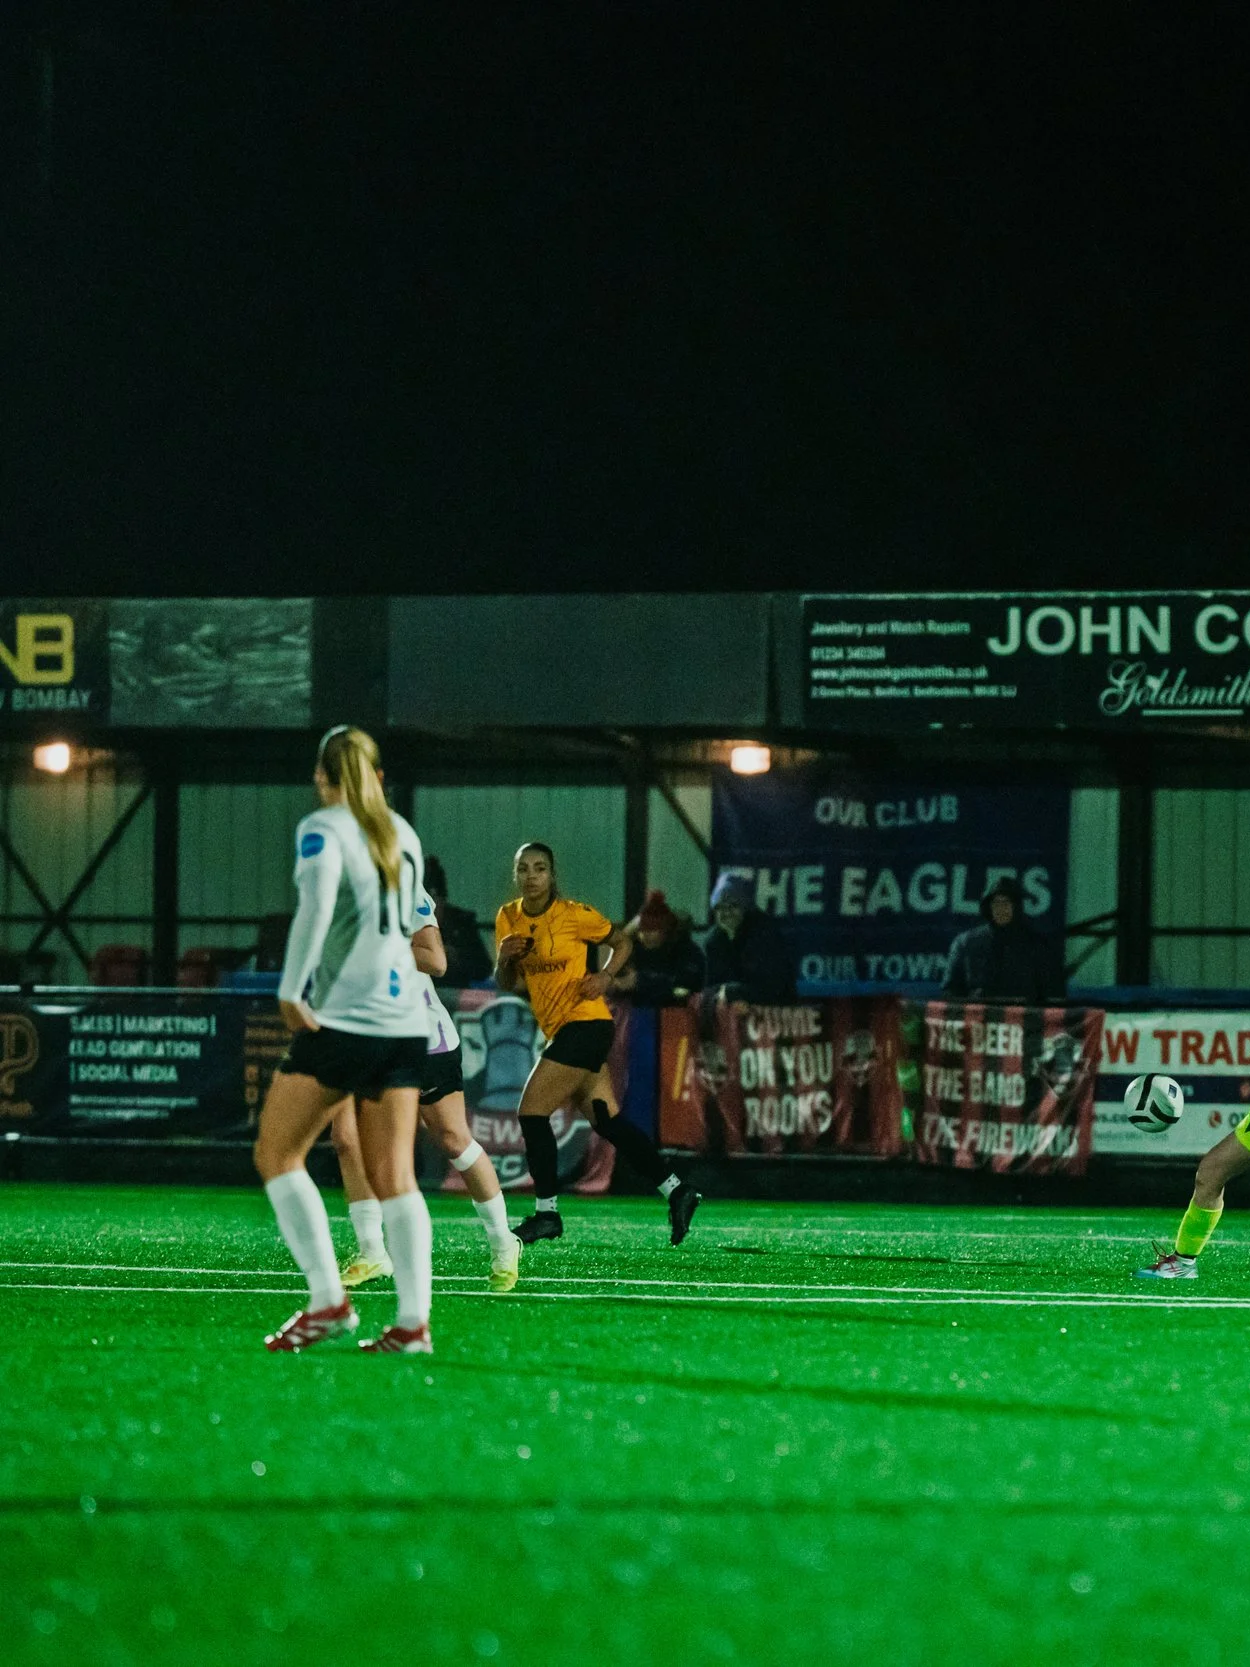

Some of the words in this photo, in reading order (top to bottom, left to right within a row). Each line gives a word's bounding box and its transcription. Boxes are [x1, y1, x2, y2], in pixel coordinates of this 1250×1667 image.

[811, 622, 863, 637] Jewellery
[865, 622, 887, 634] and
[926, 620, 971, 635] Repairs
[987, 605, 1171, 655] JOHN
[12, 689, 91, 711] BOMBAY
[814, 797, 869, 828] OUR
[875, 794, 960, 829] CLUB
[801, 954, 855, 980] OUR
[70, 1015, 113, 1033] SALES
[124, 1016, 208, 1034] MARKETING
[925, 1017, 966, 1052] THE
[970, 1022, 1024, 1056] BEER
[109, 1040, 201, 1059] GENERATION
[78, 1064, 128, 1082] SOCIAL
[132, 1065, 178, 1082] MEDIA
[740, 1047, 776, 1090] ON
[781, 1042, 833, 1086] YOU
[924, 1065, 966, 1100] THE
[970, 1070, 1026, 1108] BAND
[744, 1090, 833, 1137] ROOKS
